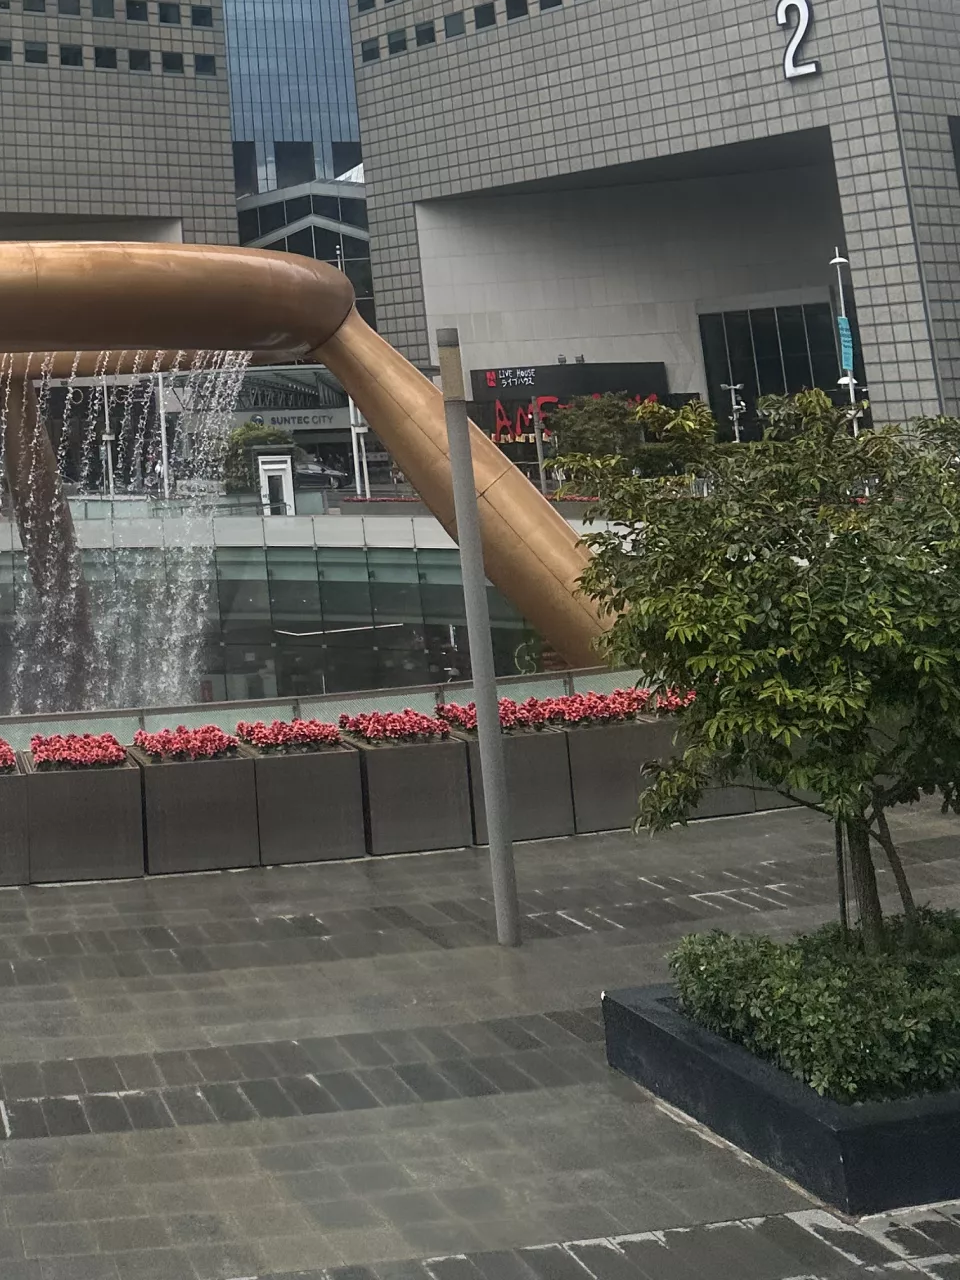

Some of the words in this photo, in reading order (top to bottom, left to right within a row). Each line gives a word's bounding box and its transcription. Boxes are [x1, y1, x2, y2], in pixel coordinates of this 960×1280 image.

[499, 370, 513, 378] LIVE
[516, 369, 535, 377] HOUSE
[270, 416, 310, 425] SUNTEC
[312, 415, 334, 424] CITY
